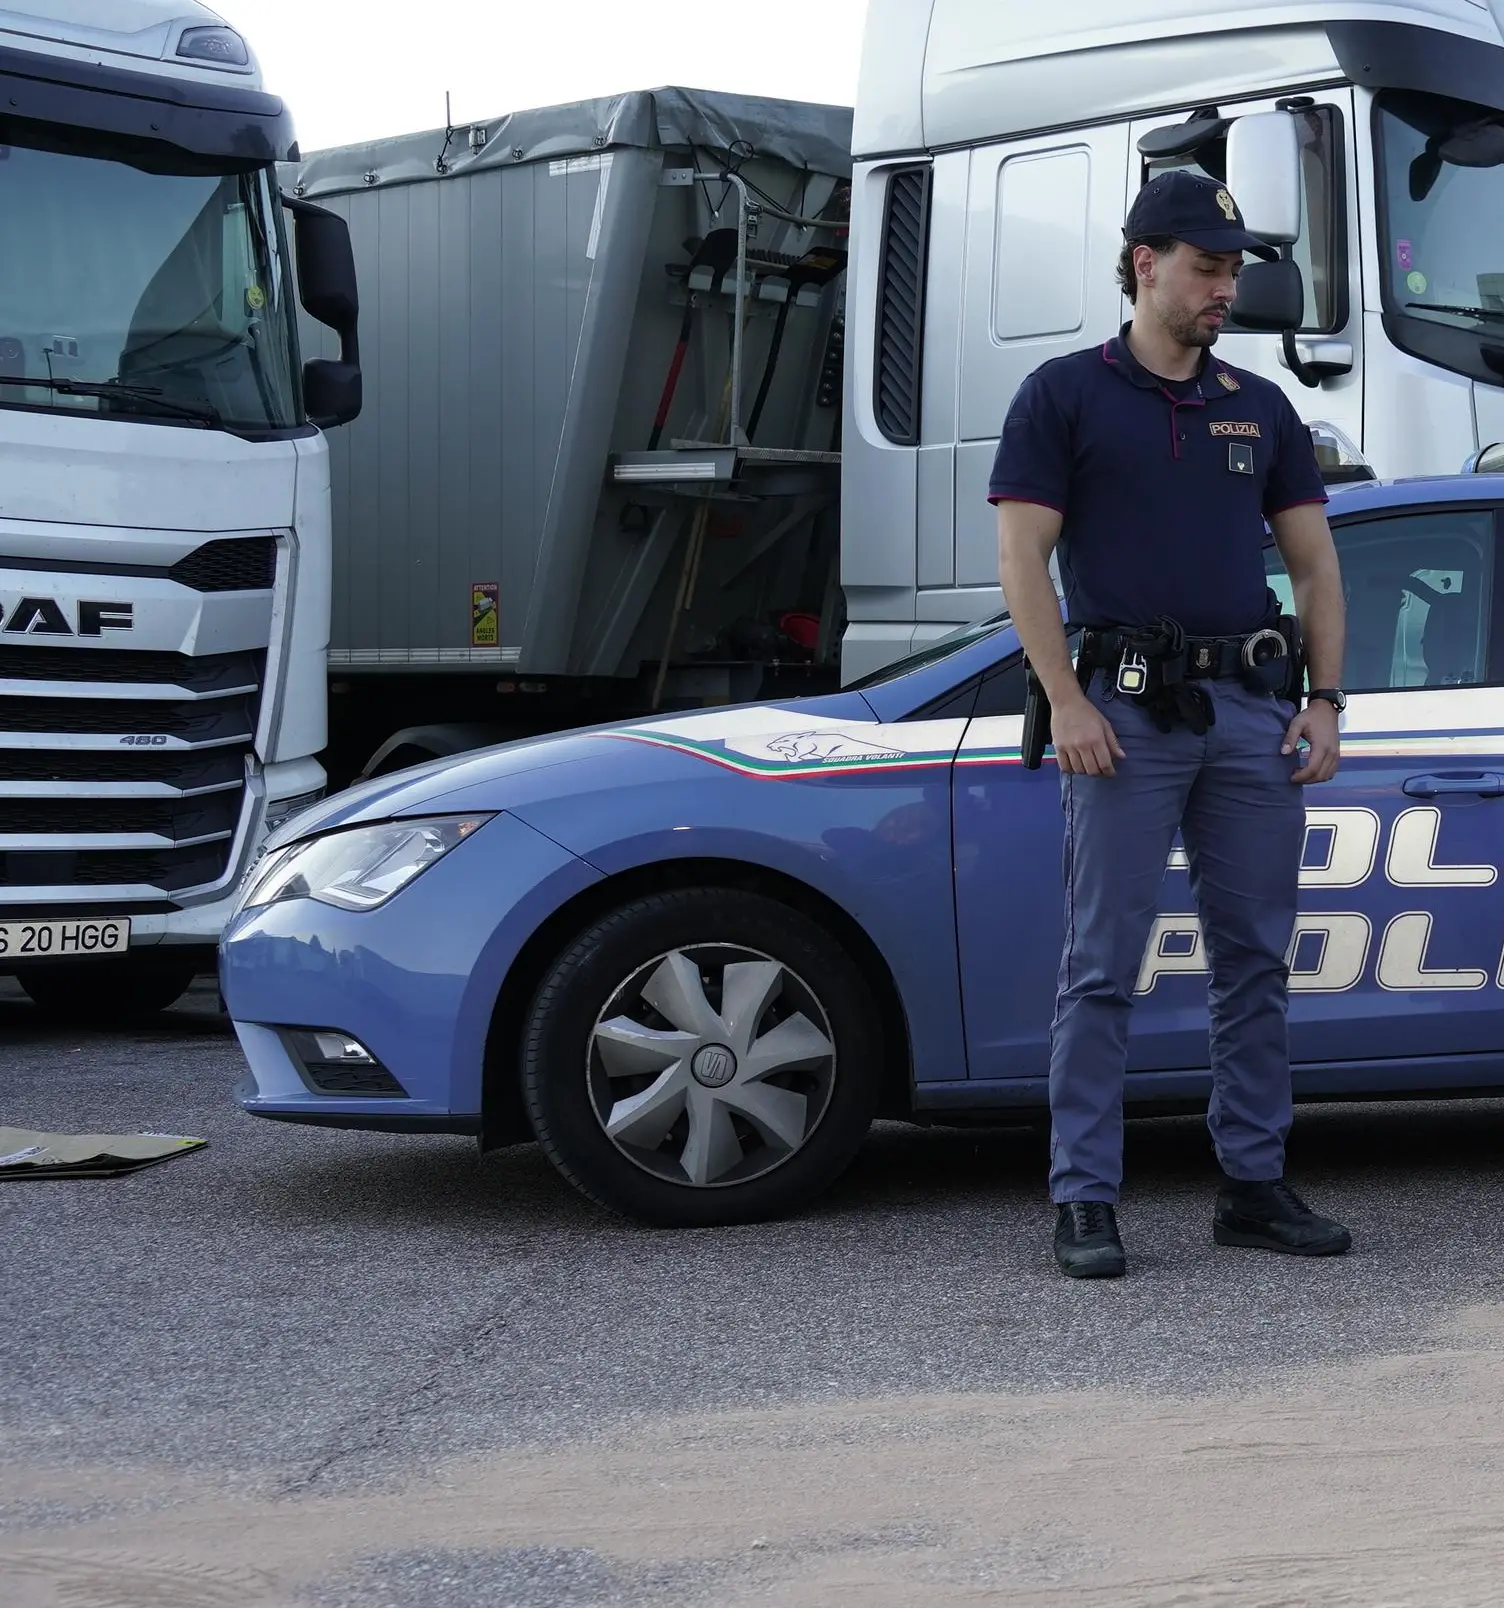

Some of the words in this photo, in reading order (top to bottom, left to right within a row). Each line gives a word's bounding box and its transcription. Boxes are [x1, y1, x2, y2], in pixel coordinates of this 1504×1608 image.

[1211, 423, 1258, 436] POLIZIA
[0, 596, 134, 638] AF
[822, 755, 863, 764] SQUADRA
[20, 925, 53, 953] 20
[60, 923, 119, 951] HGG
